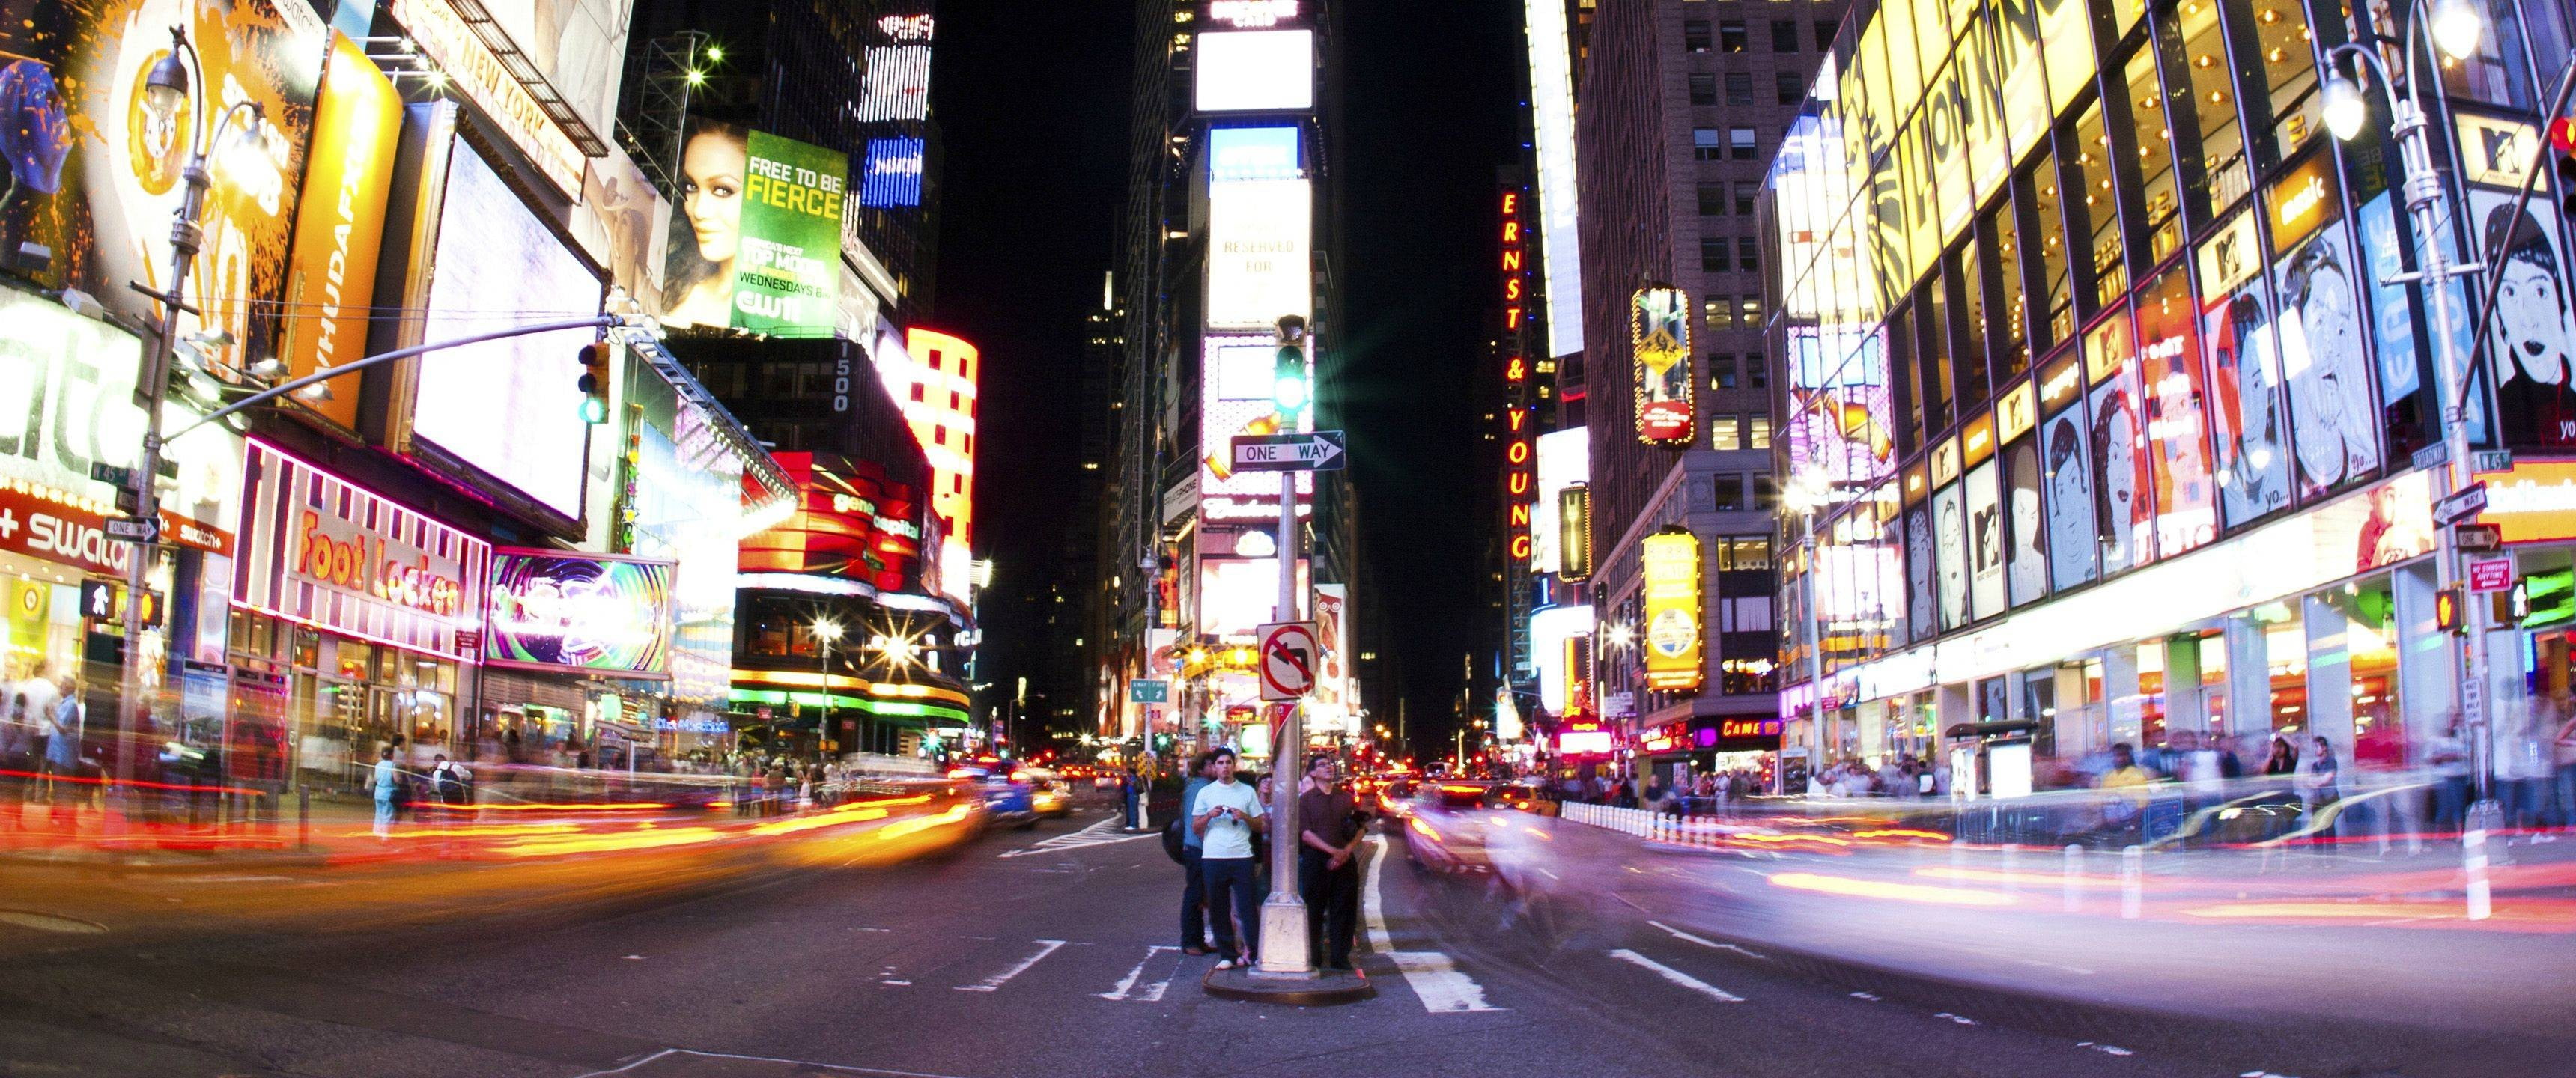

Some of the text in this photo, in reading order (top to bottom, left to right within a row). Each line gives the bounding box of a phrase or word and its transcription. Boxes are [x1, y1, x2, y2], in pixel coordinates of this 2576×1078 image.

[461, 34, 501, 95] NEW
[503, 78, 545, 138] YORK
[749, 156, 842, 194] FREE TO BE
[746, 173, 840, 219] FIERCE
[2280, 175, 2326, 226] music
[742, 246, 774, 266] TOP
[1224, 240, 1294, 253] RESERVED
[1245, 261, 1272, 272] FOR
[739, 271, 814, 296] WEDNESDAYS
[833, 341, 851, 412] 1500
[1503, 193, 1529, 558] ERNST & YOUNG
[1246, 443, 1330, 460] ONE WAY
[2413, 443, 2446, 470] BROADWAY
[2481, 453, 2490, 471] W
[2491, 453, 2502, 470] 45
[104, 466, 115, 481] 45
[833, 493, 920, 540] gene ospital
[2438, 505, 2453, 520] ONE
[2463, 492, 2479, 509] WAY
[113, 521, 153, 535] ONE WAY
[180, 523, 217, 548] swatch
[297, 510, 367, 591] Foot
[2472, 563, 2508, 574] NO STANDING
[2476, 571, 2504, 581] ANYTIME
